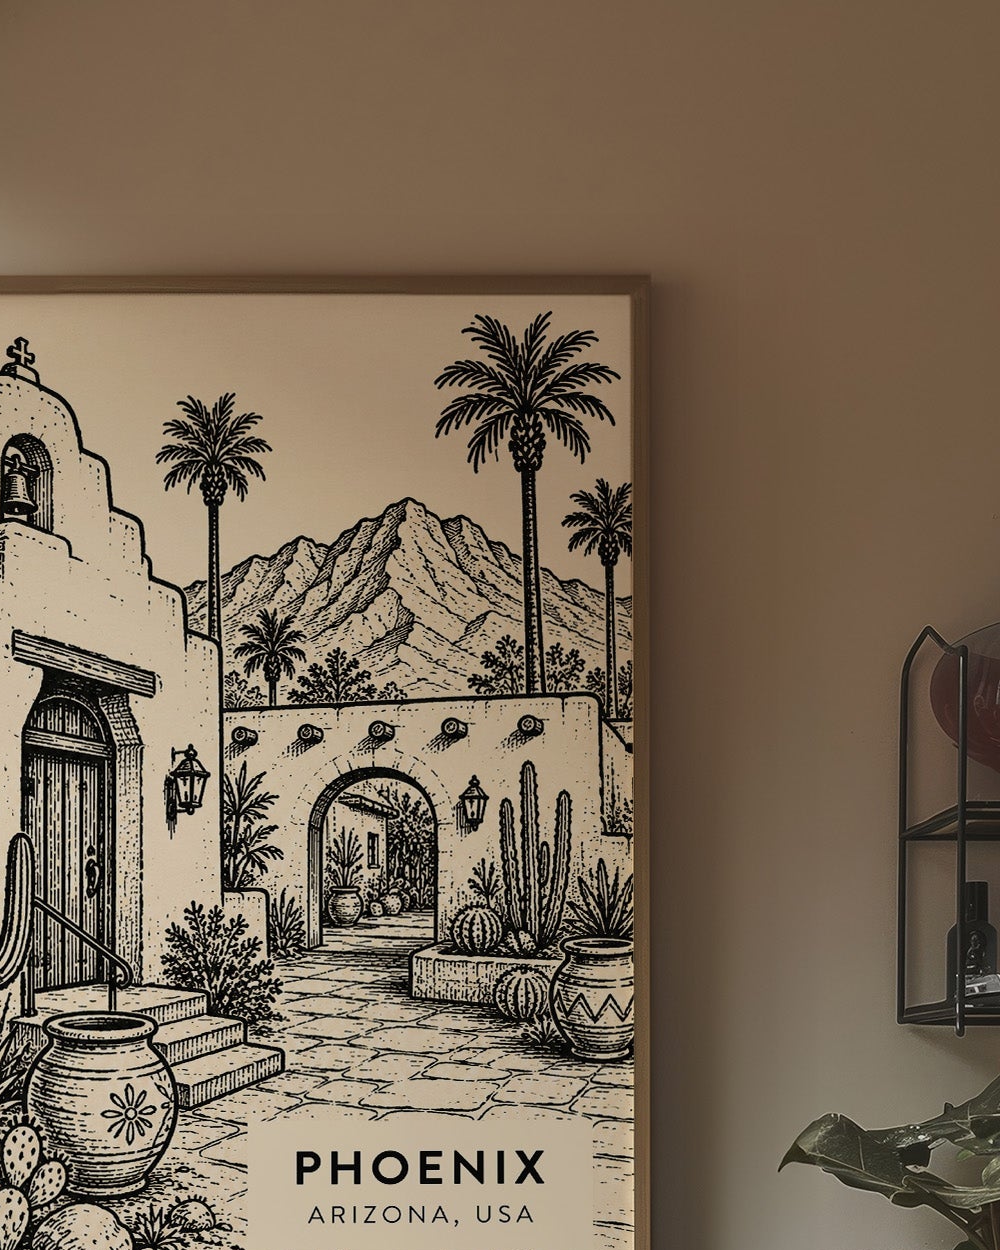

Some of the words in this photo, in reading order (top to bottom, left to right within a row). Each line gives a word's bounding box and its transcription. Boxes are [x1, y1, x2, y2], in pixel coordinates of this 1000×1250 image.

[296, 1150, 545, 1185] PHOENIX
[308, 1205, 460, 1227] ARIZONA,
[476, 1205, 534, 1223] USA
